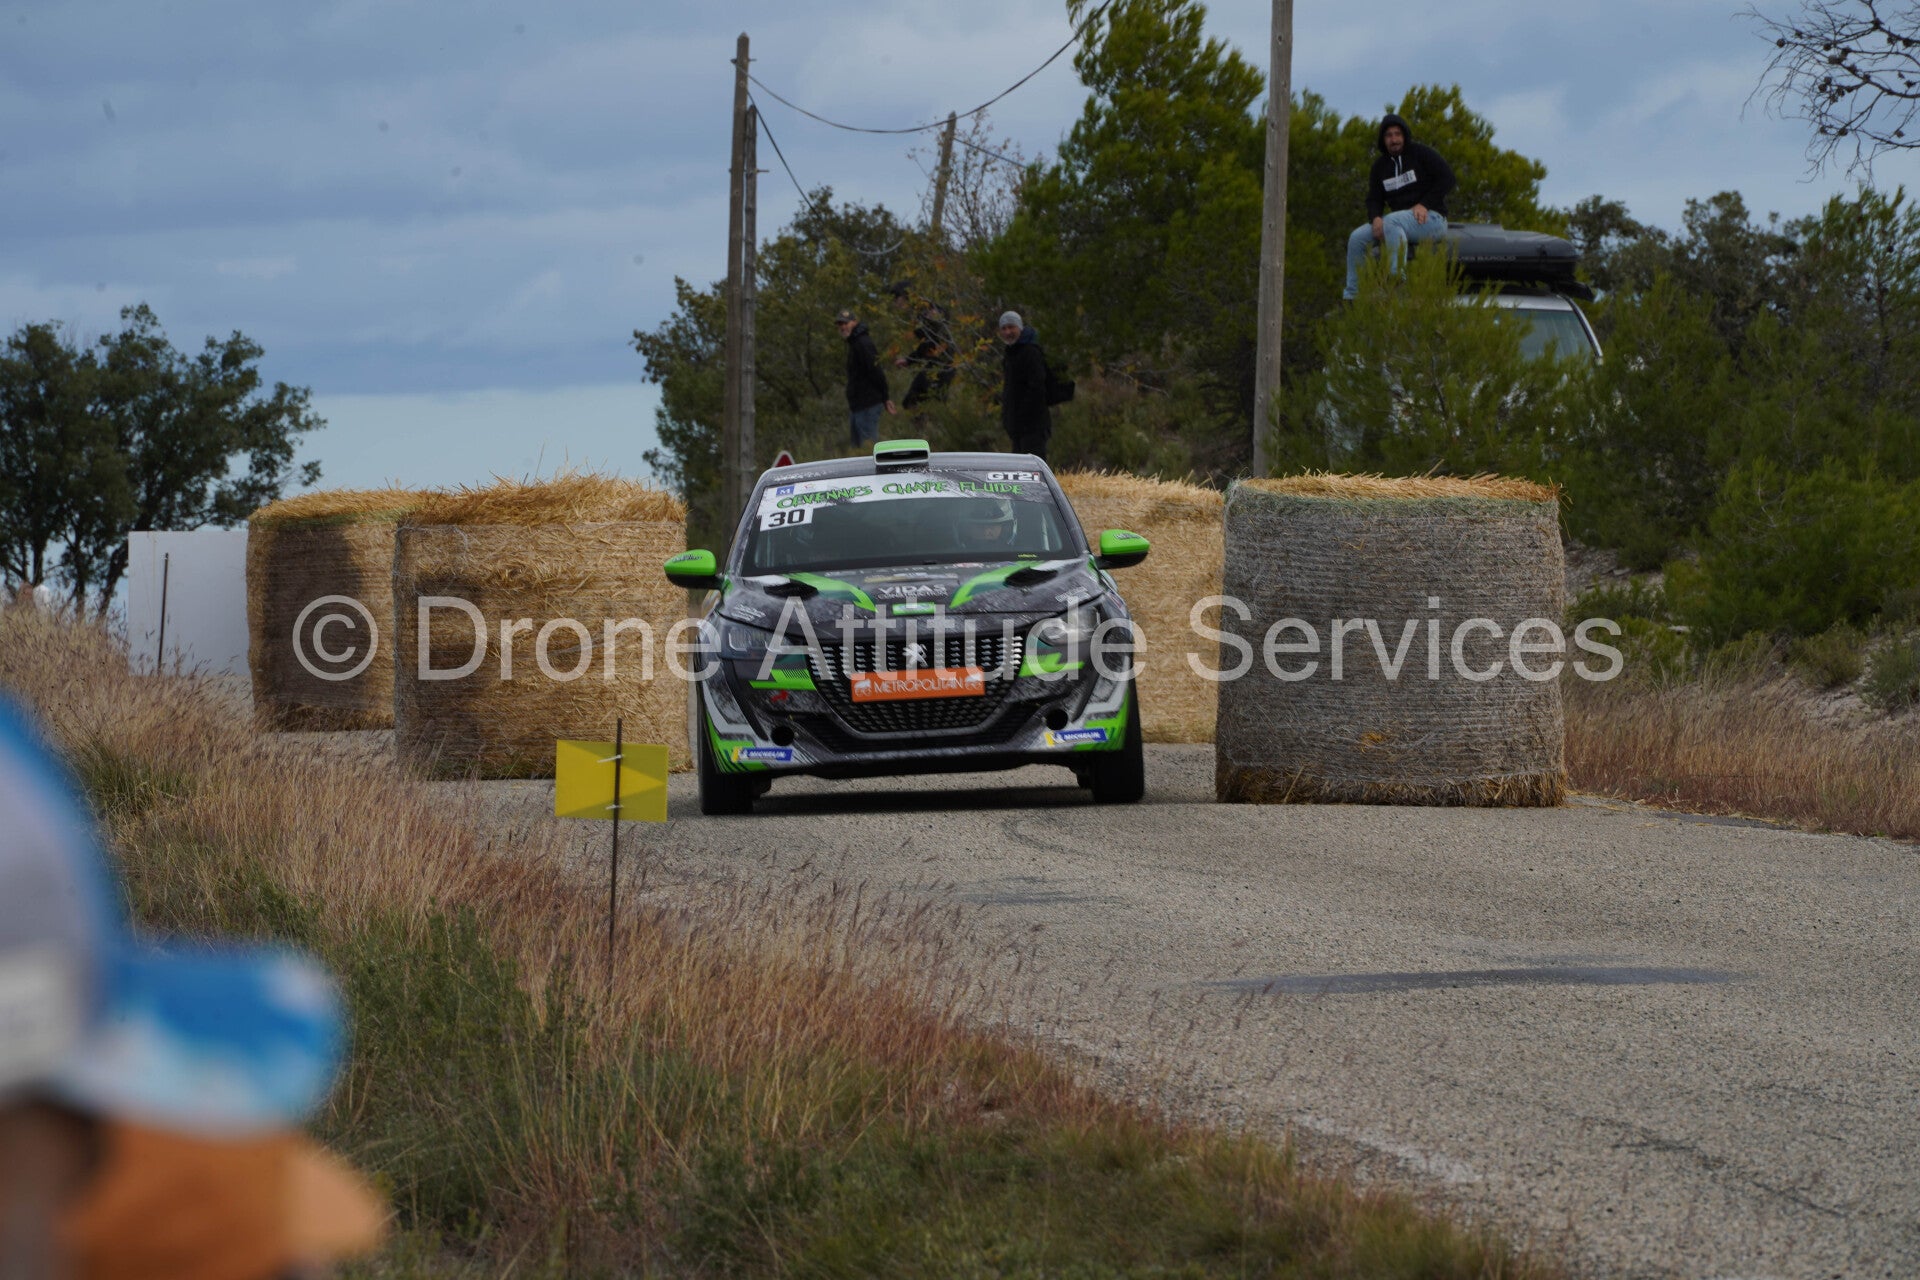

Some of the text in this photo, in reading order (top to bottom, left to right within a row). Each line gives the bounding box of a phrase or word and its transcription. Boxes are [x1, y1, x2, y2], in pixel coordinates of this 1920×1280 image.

[987, 471, 1040, 482] GT2i
[776, 480, 1024, 508] CEVENNES CHAPE FLUIDE
[768, 509, 806, 528] 30
[1063, 731, 1102, 741] MICHELIN
[748, 750, 787, 759] MICHELIN
